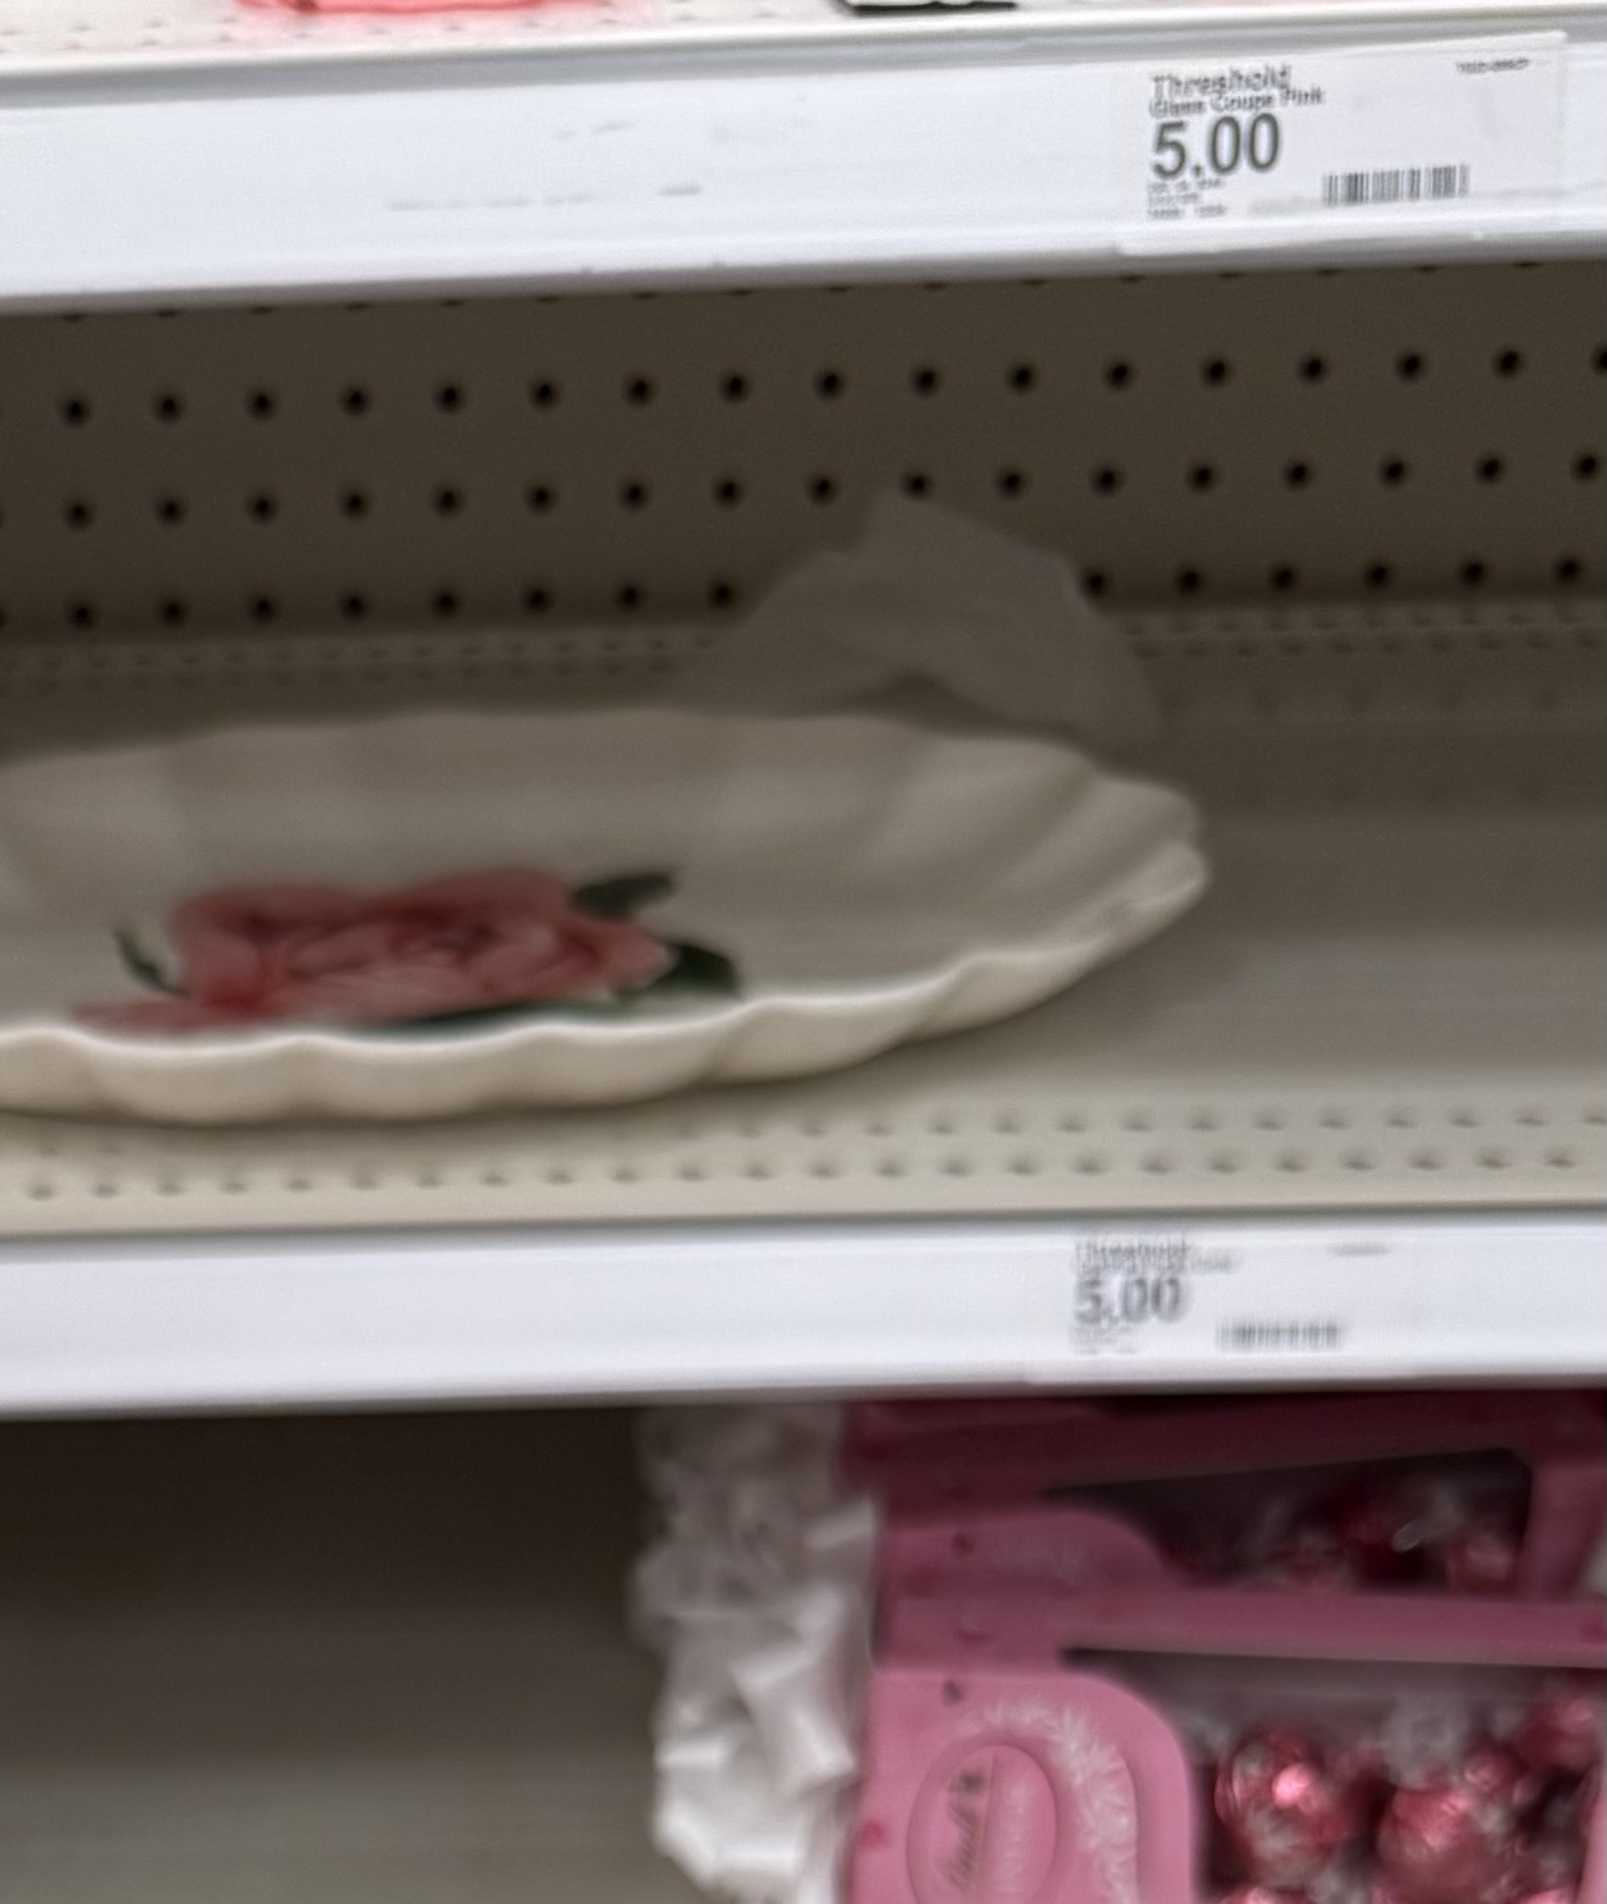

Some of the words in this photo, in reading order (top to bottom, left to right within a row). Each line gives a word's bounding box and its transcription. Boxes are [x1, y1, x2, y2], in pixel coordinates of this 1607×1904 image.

[1151, 65, 1292, 98] Threshold
[1151, 113, 1280, 179] 5.00
[1074, 1274, 1184, 1325] 5.00
